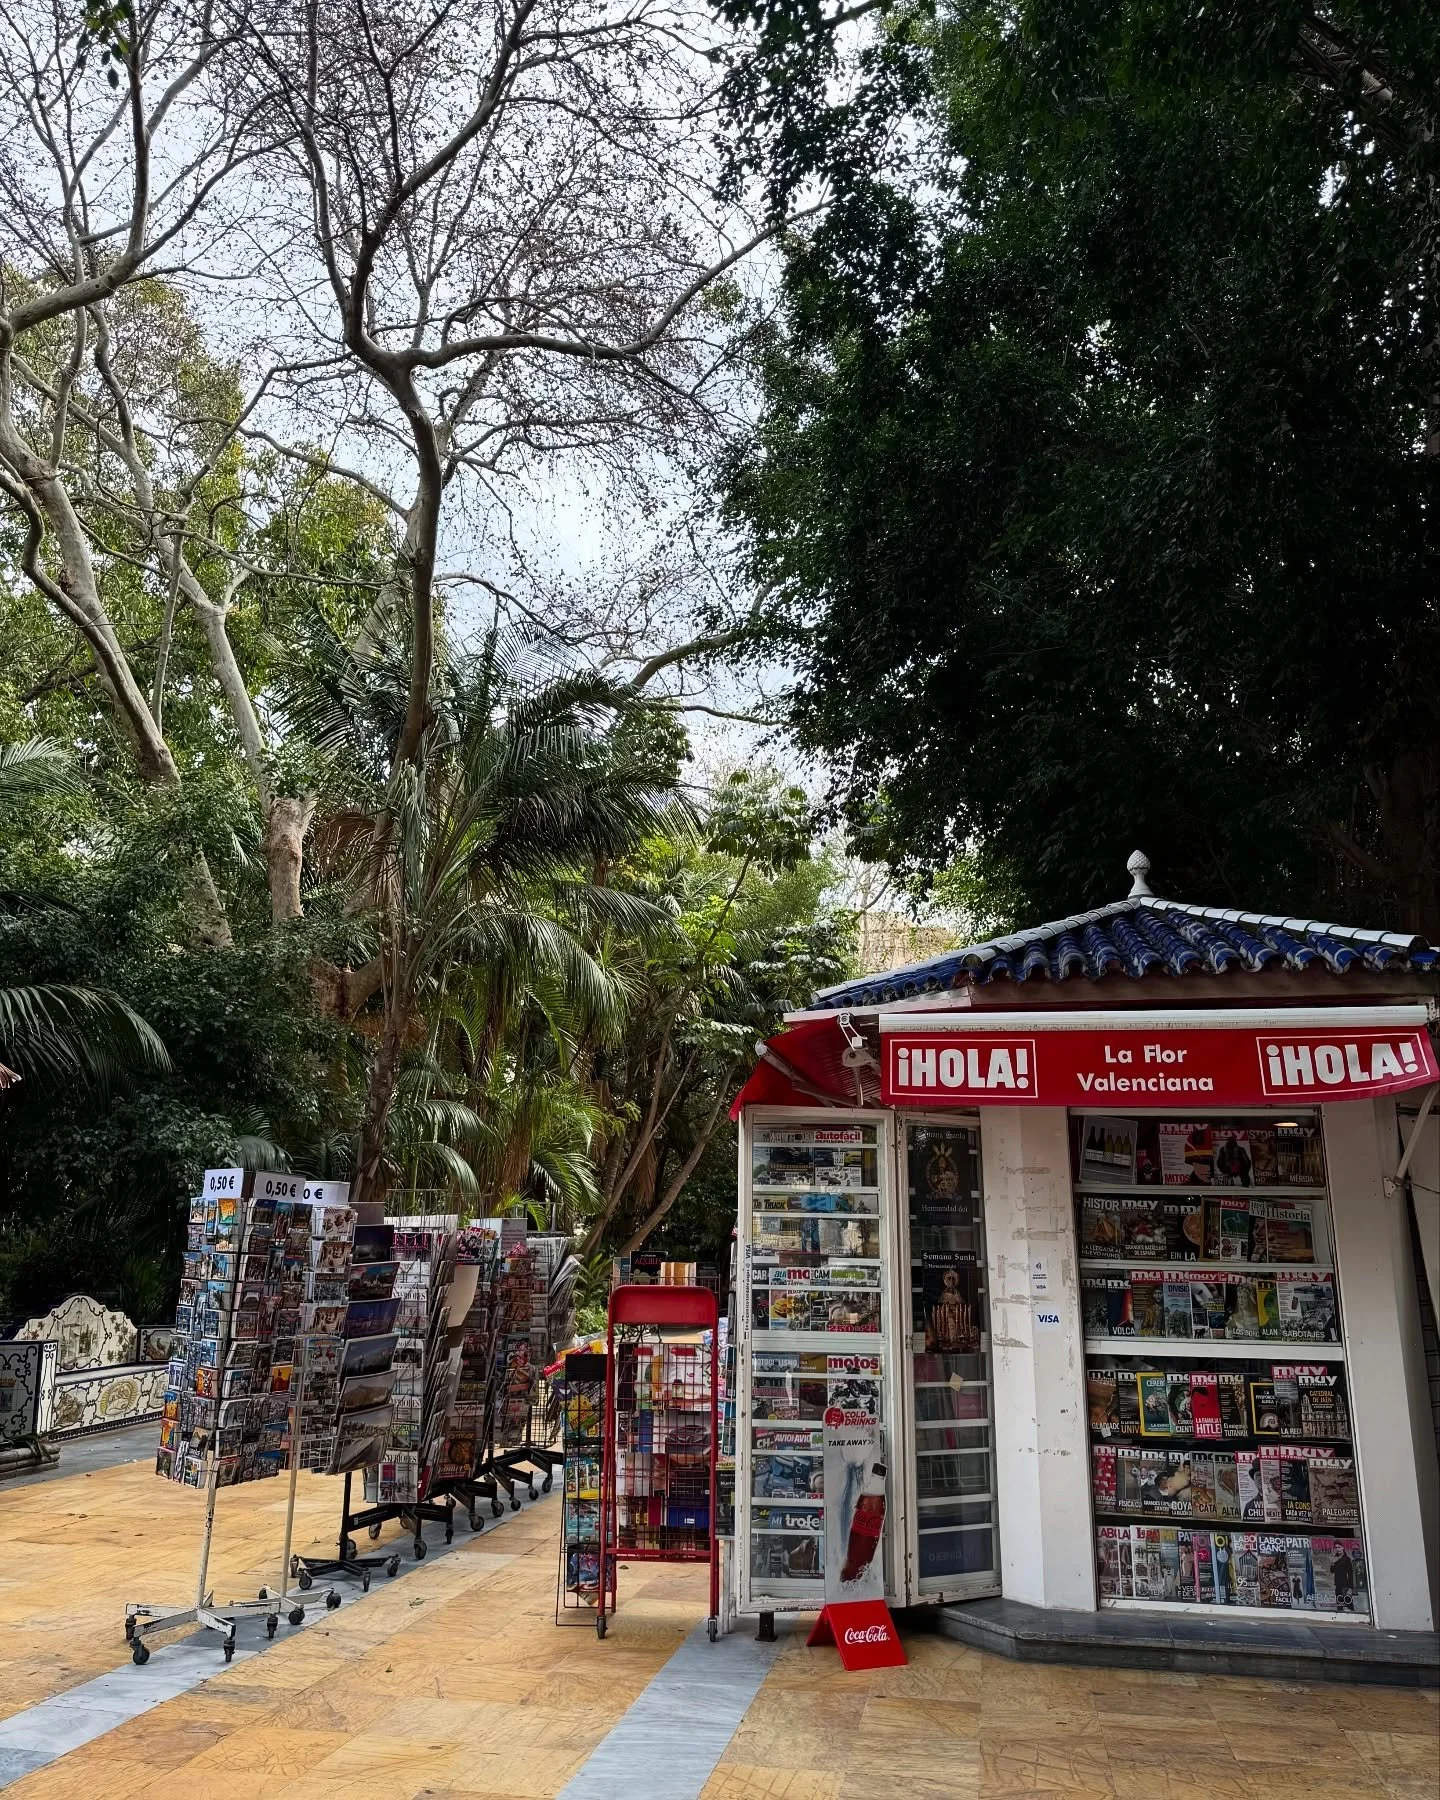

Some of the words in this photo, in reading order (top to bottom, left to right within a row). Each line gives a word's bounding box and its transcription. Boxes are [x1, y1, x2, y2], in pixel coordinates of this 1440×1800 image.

[1104, 1044, 1133, 1063] La
[1143, 1044, 1188, 1063] Flor
[897, 1047, 1029, 1089] ¡HOLA!
[1265, 1042, 1419, 1086] ¡HOLA!
[1077, 1072, 1214, 1091] Valenciana
[815, 1131, 861, 1140] autofácil
[1278, 1127, 1315, 1137] muy
[210, 1176, 227, 1192] 0,50
[228, 1175, 235, 1189] €
[265, 1180, 288, 1197] 0,50
[289, 1184, 297, 1197] €
[313, 1188, 323, 1199] €
[1121, 1200, 1159, 1209] muy
[1266, 1208, 1310, 1220] Historia
[923, 1252, 952, 1260] Semana
[954, 1253, 975, 1261] Santa
[1037, 1314, 1059, 1323] VISA
[1282, 1330, 1325, 1339] SABOTAJES
[828, 1357, 879, 1369] motos
[1299, 1376, 1337, 1386] muy
[844, 1418, 877, 1426] DRINKS
[1280, 1446, 1334, 1457] muy
[1309, 1459, 1352, 1469] muy
[1171, 1501, 1192, 1510] GOYA
[1322, 1508, 1358, 1516] PALEOARTE
[845, 1625, 888, 1645] Coca-Cola
